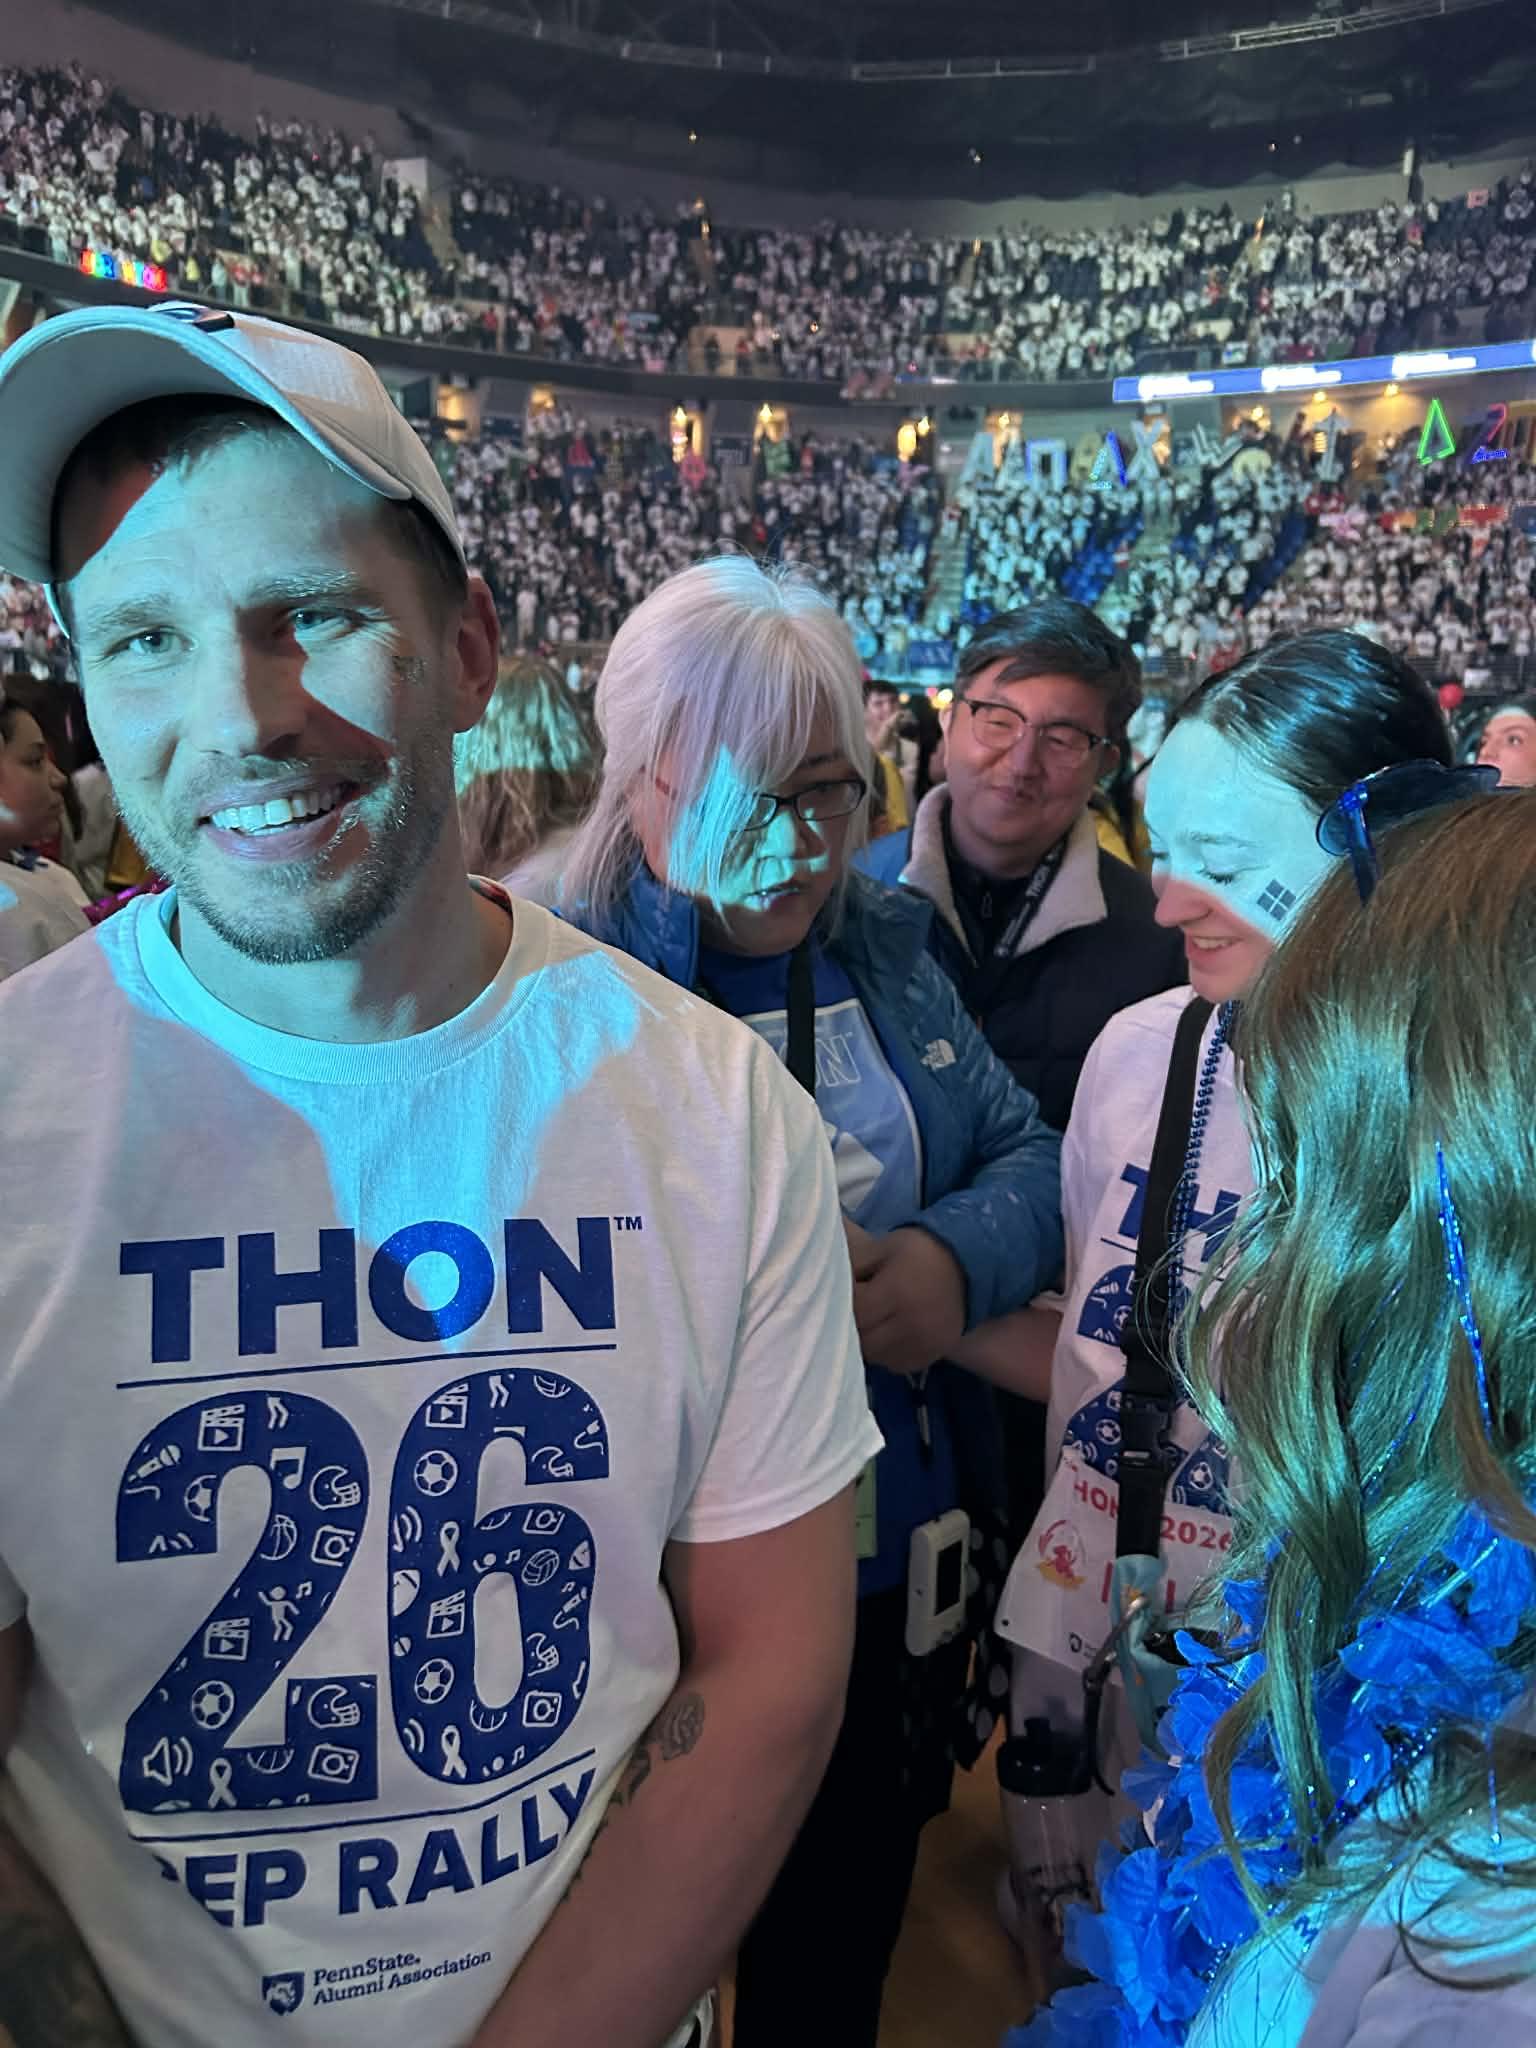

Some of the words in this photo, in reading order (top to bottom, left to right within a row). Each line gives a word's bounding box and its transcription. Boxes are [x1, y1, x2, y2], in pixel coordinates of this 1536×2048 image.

[120, 1217, 616, 1364] THON
[116, 1367, 610, 1815] 26
[152, 1849, 308, 1928] EP
[338, 1767, 596, 1915] RALLY
[313, 1976, 384, 2006] Alumni
[389, 1951, 492, 1989] Association
